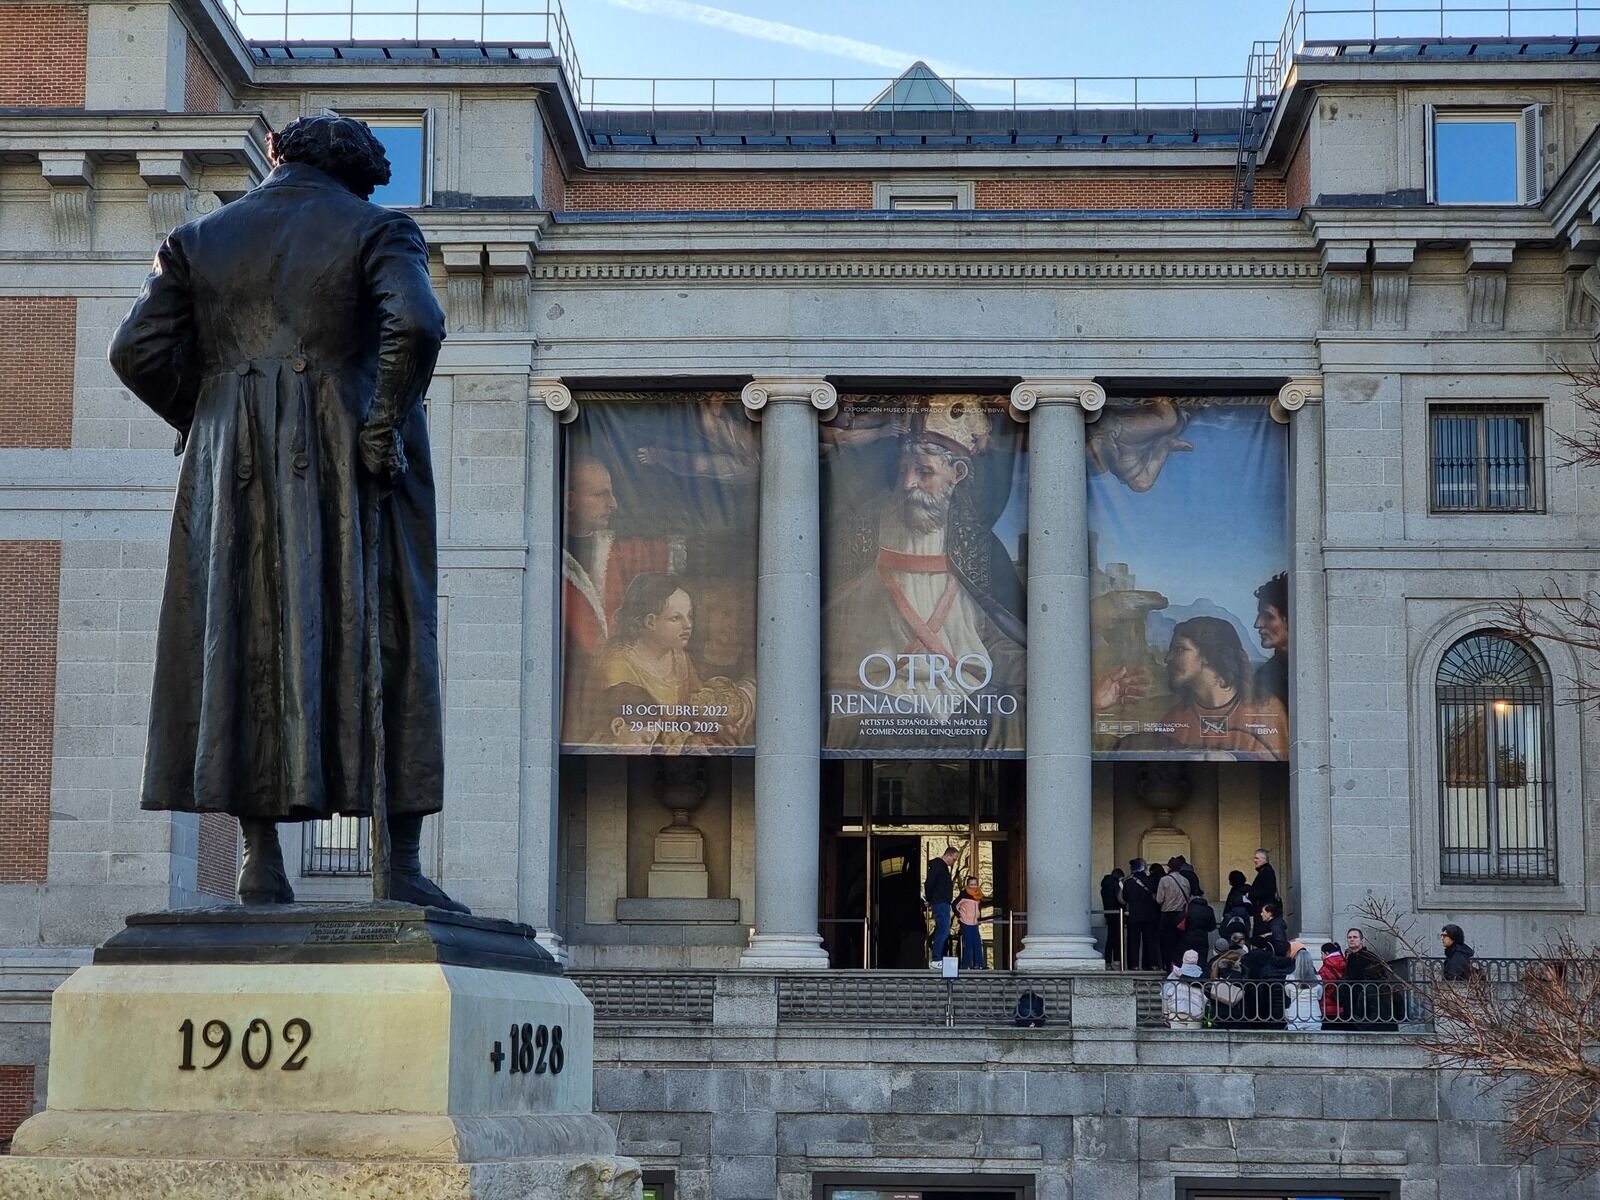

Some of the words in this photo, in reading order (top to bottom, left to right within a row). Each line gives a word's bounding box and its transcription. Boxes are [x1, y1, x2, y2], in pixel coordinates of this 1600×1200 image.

[858, 653, 993, 690] OTRO
[621, 704, 633, 715] 18
[635, 704, 700, 716] OCTUBRE
[702, 705, 728, 717] 2022
[830, 694, 1018, 714] RENACIMIENTO
[630, 720, 643, 732] 29
[647, 721, 691, 732] ENERO
[694, 721, 720, 733] 2023
[896, 716, 938, 726] ESPAÑOLES
[953, 717, 988, 726] NÁPOLES
[866, 728, 914, 736] COMIENZOS
[931, 728, 988, 738] CINQUECENTO
[177, 1017, 312, 1071] 1902
